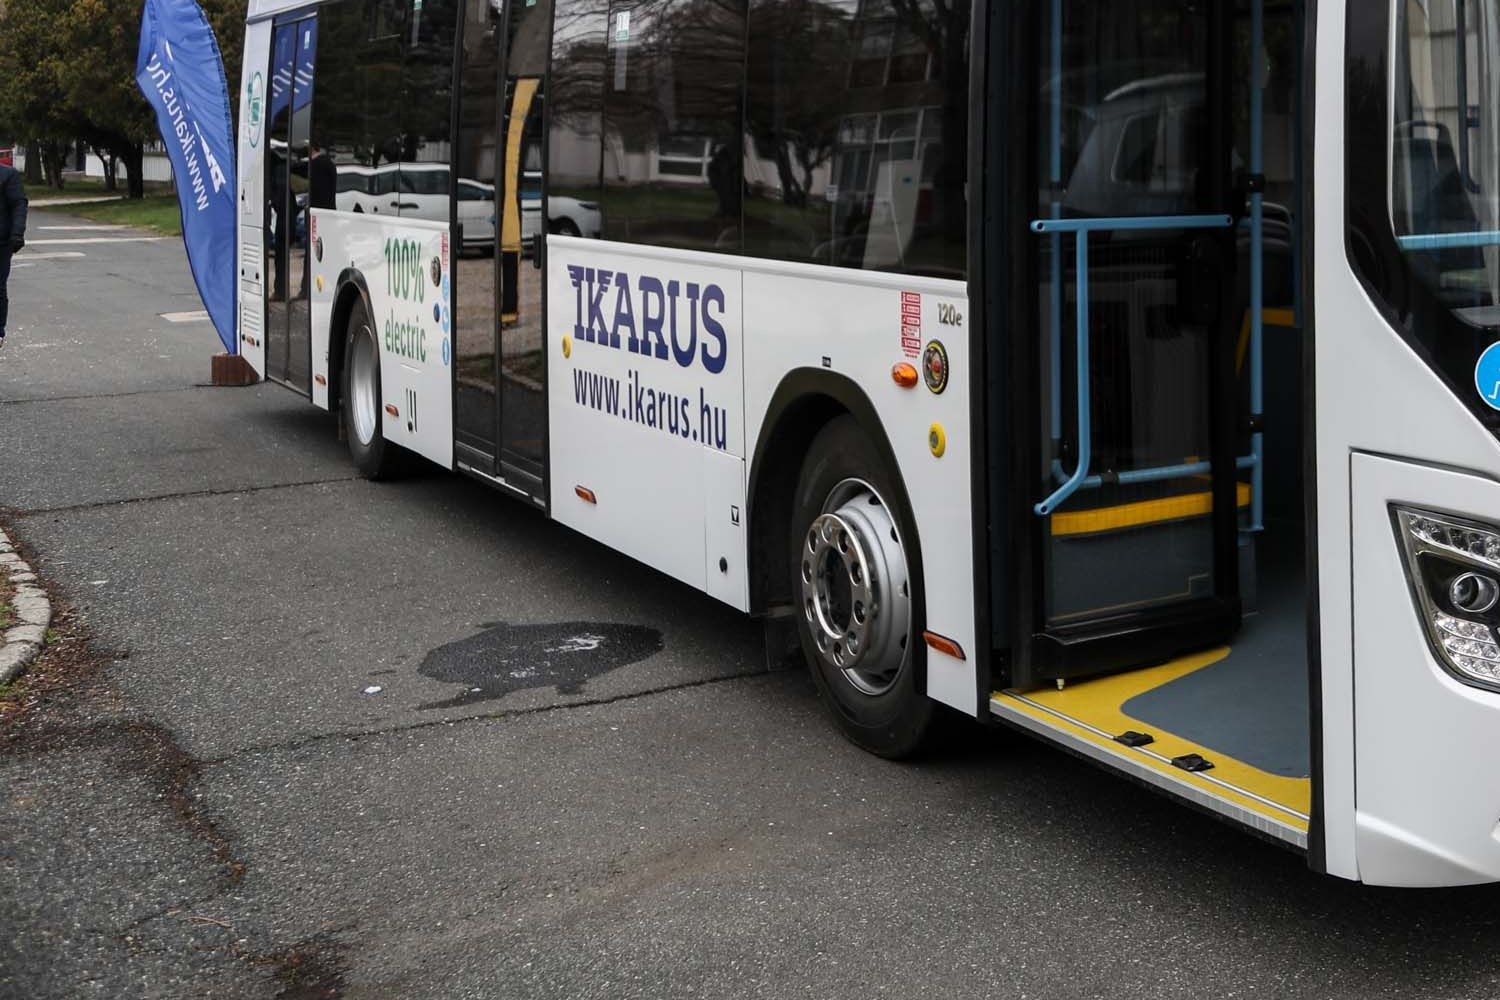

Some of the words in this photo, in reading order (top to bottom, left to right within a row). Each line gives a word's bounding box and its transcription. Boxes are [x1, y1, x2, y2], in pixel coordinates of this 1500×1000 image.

[385, 237, 425, 304] 100%
[385, 308, 426, 363] electric
[567, 264, 728, 375] IKARUS
[937, 302, 963, 328] 120e
[573, 367, 727, 451] www.ikarus.hu
